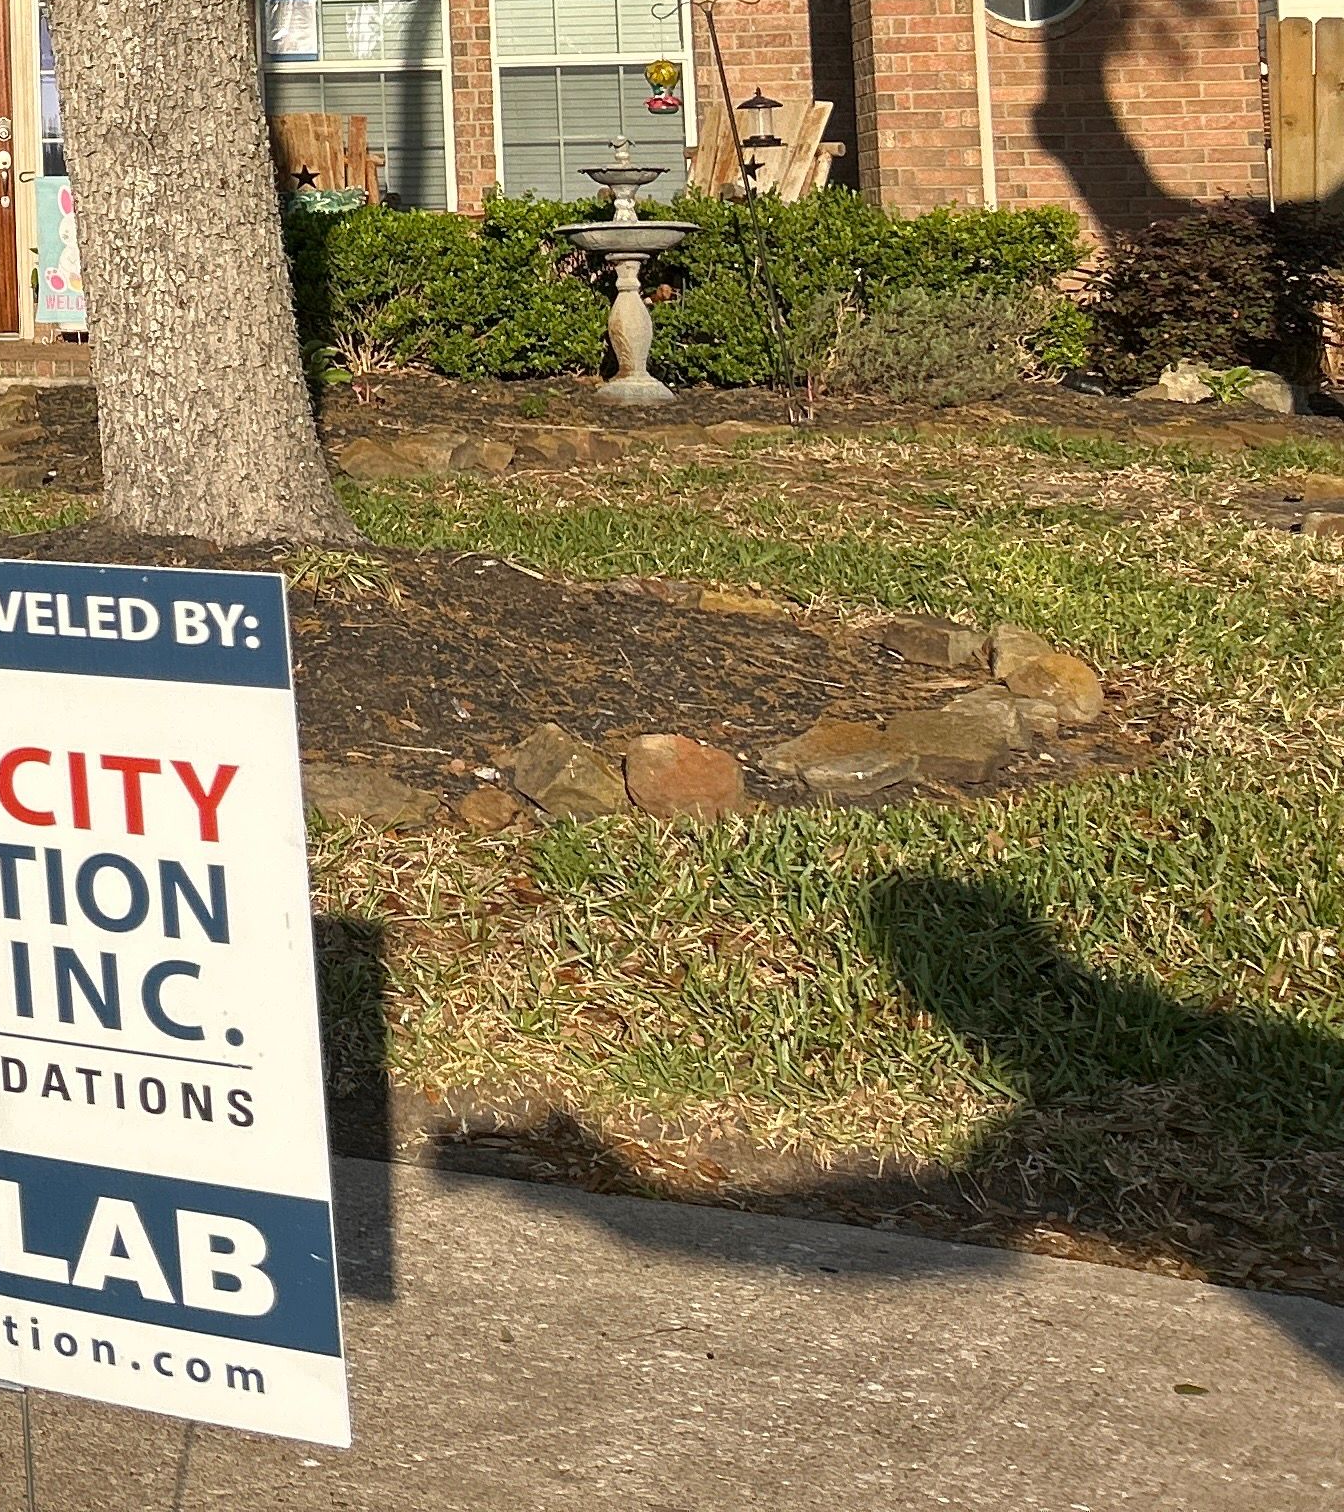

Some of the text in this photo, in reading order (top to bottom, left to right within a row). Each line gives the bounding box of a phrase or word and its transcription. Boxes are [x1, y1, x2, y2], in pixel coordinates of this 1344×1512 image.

[46, 294, 86, 311] WELC
[174, 601, 259, 648] BY:
[11, 941, 243, 1046] INC.
